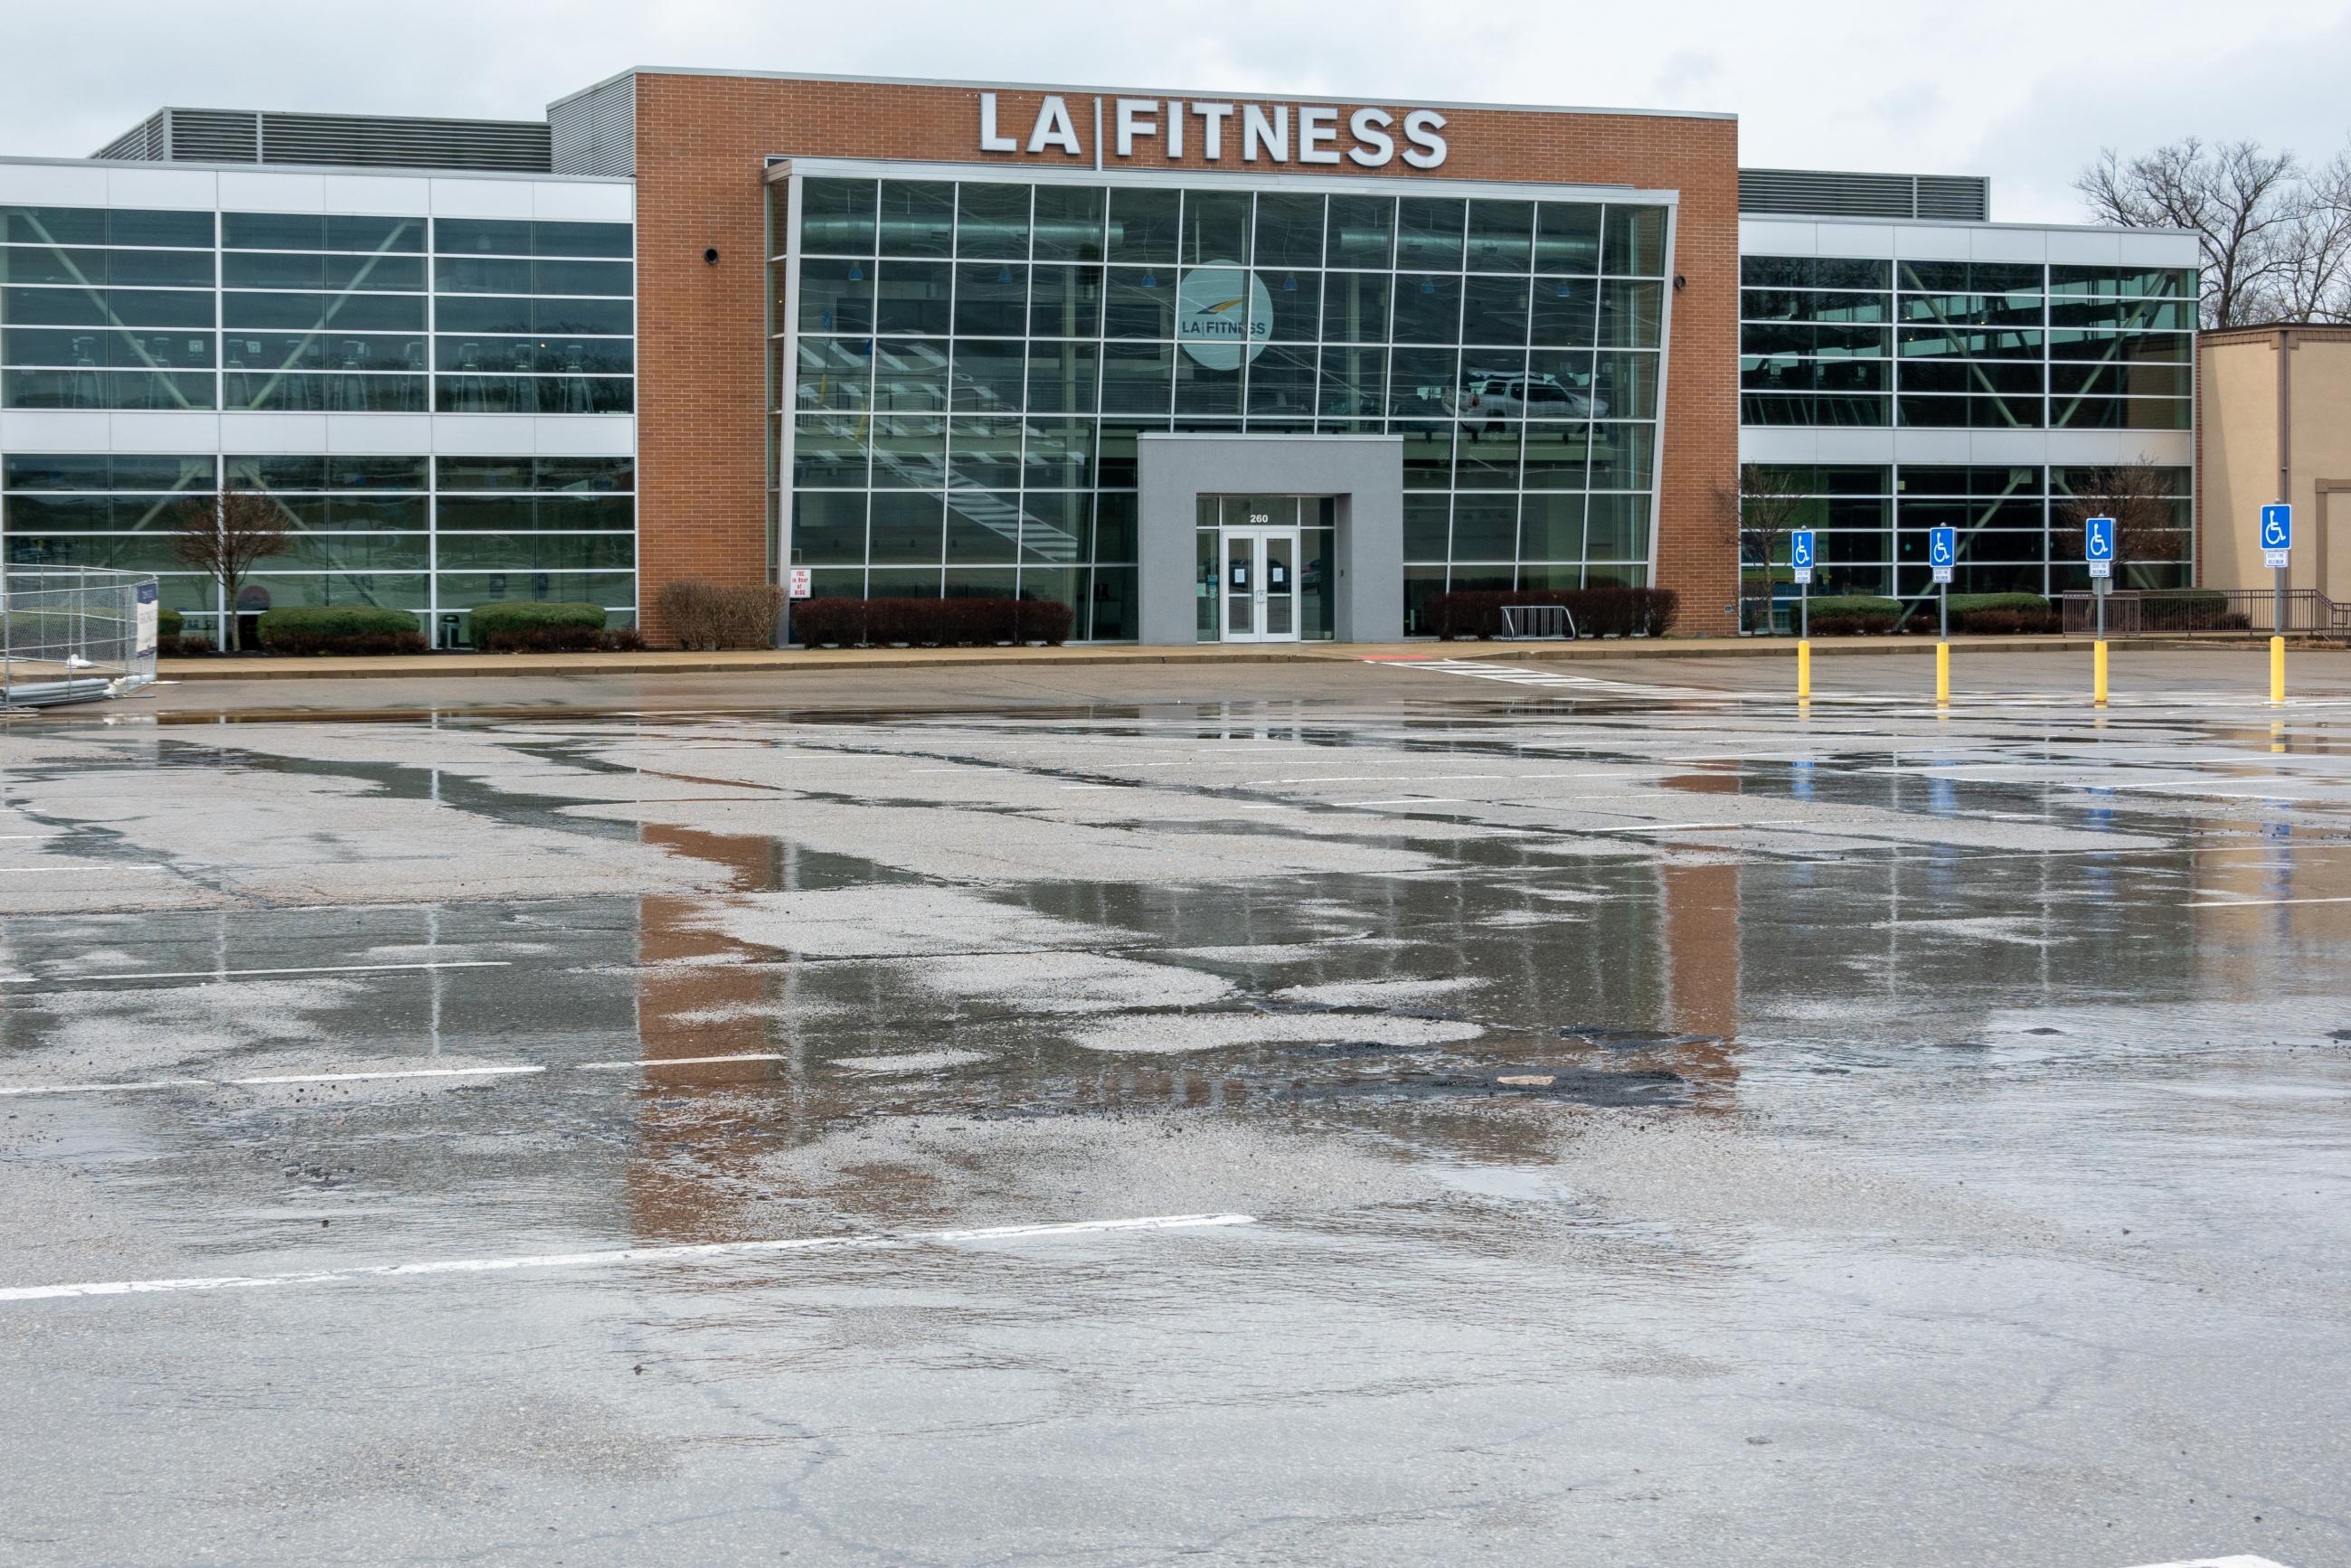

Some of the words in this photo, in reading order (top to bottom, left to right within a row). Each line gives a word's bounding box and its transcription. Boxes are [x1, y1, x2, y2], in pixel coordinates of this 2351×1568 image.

[979, 92, 1081, 156] LA
[1115, 98, 1449, 169] FITNESS
[1182, 321, 1201, 334] LA
[1250, 514, 1269, 524] 260
